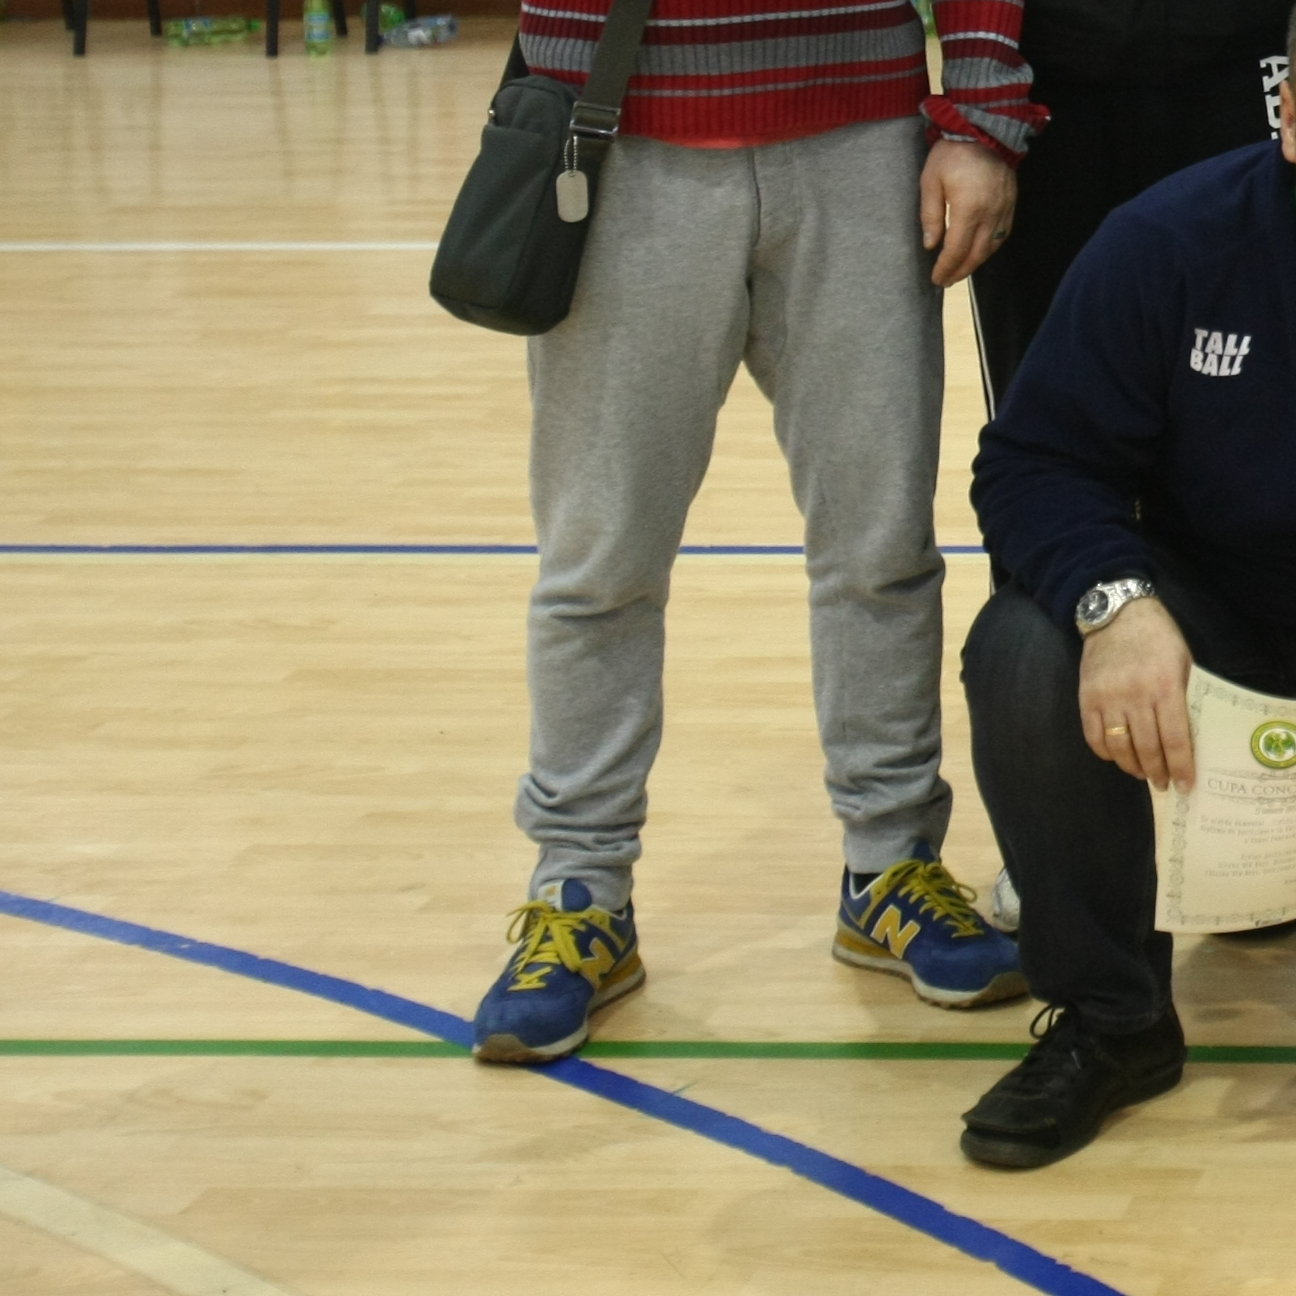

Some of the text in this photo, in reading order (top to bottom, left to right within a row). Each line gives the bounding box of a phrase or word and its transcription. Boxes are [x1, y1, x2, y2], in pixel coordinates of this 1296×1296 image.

[1193, 328, 1252, 356] TALL
[1189, 347, 1244, 377] BALL
[1207, 778, 1246, 794] CUPA
[870, 903, 921, 960] N
